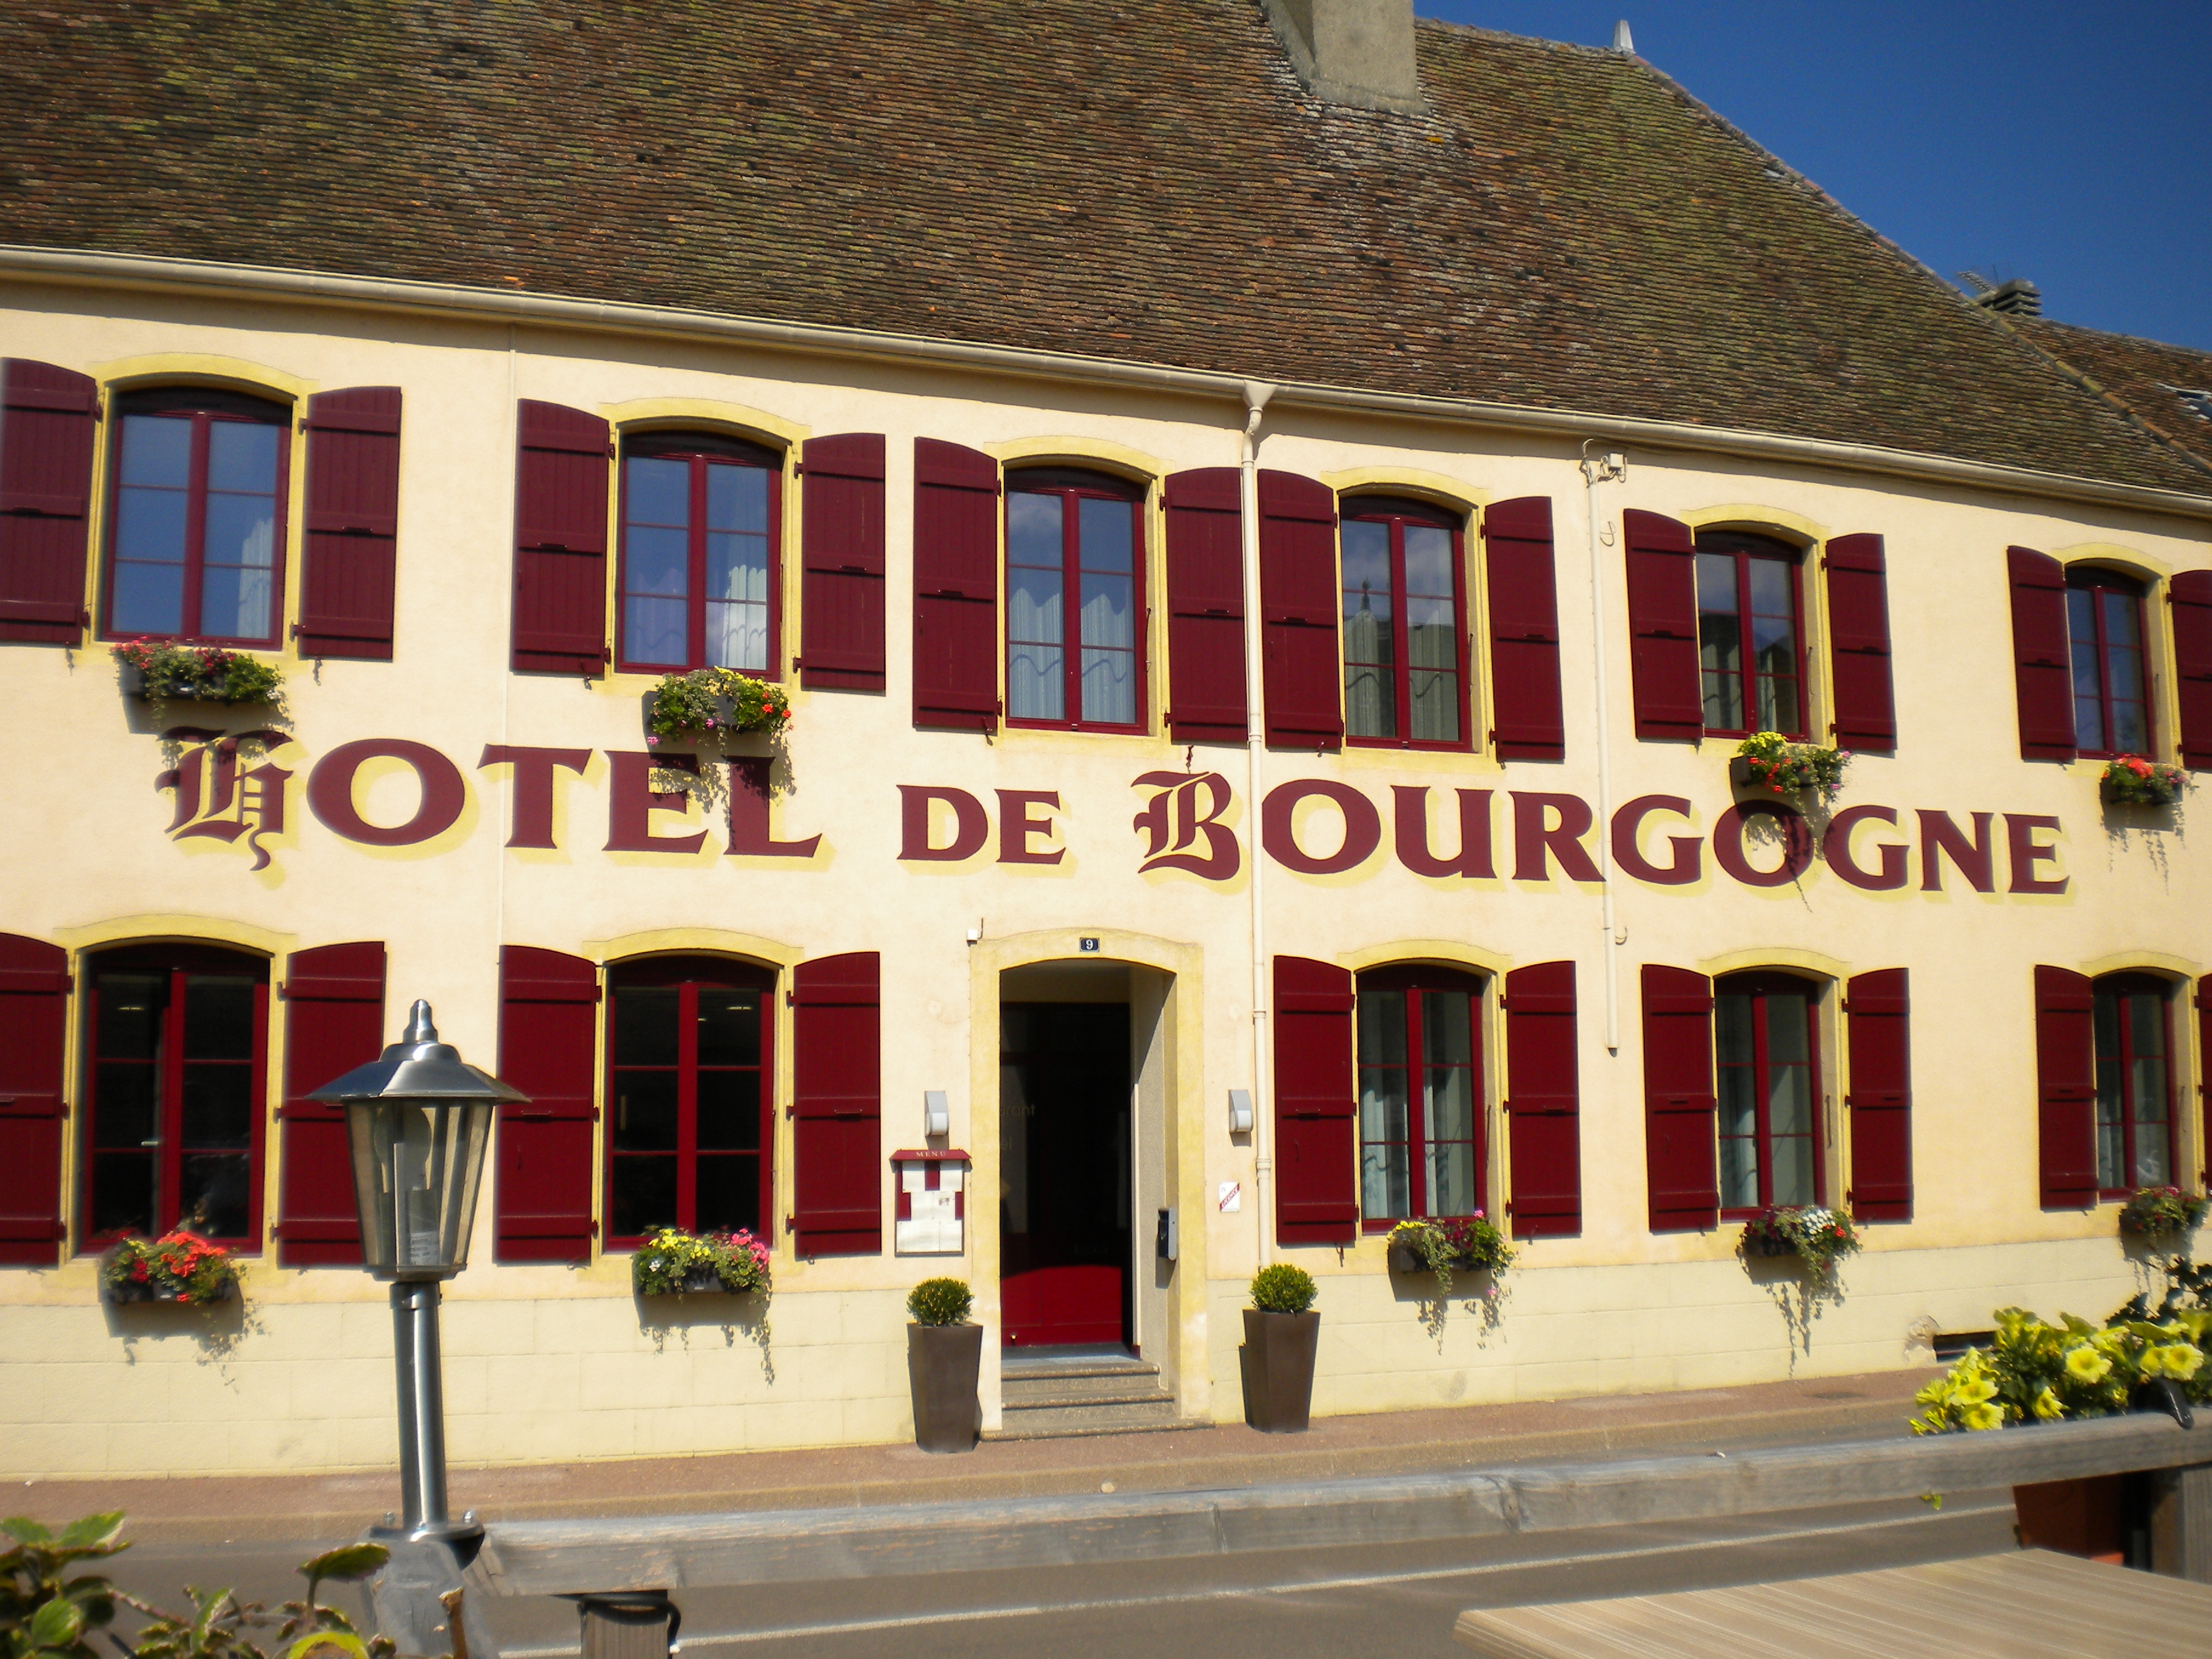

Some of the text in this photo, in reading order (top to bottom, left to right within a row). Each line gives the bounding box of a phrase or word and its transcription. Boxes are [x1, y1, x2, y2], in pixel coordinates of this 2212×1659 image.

[155, 726, 2070, 895] HOTEL DE BOURGOGNE
[1085, 939, 1094, 950] 9
